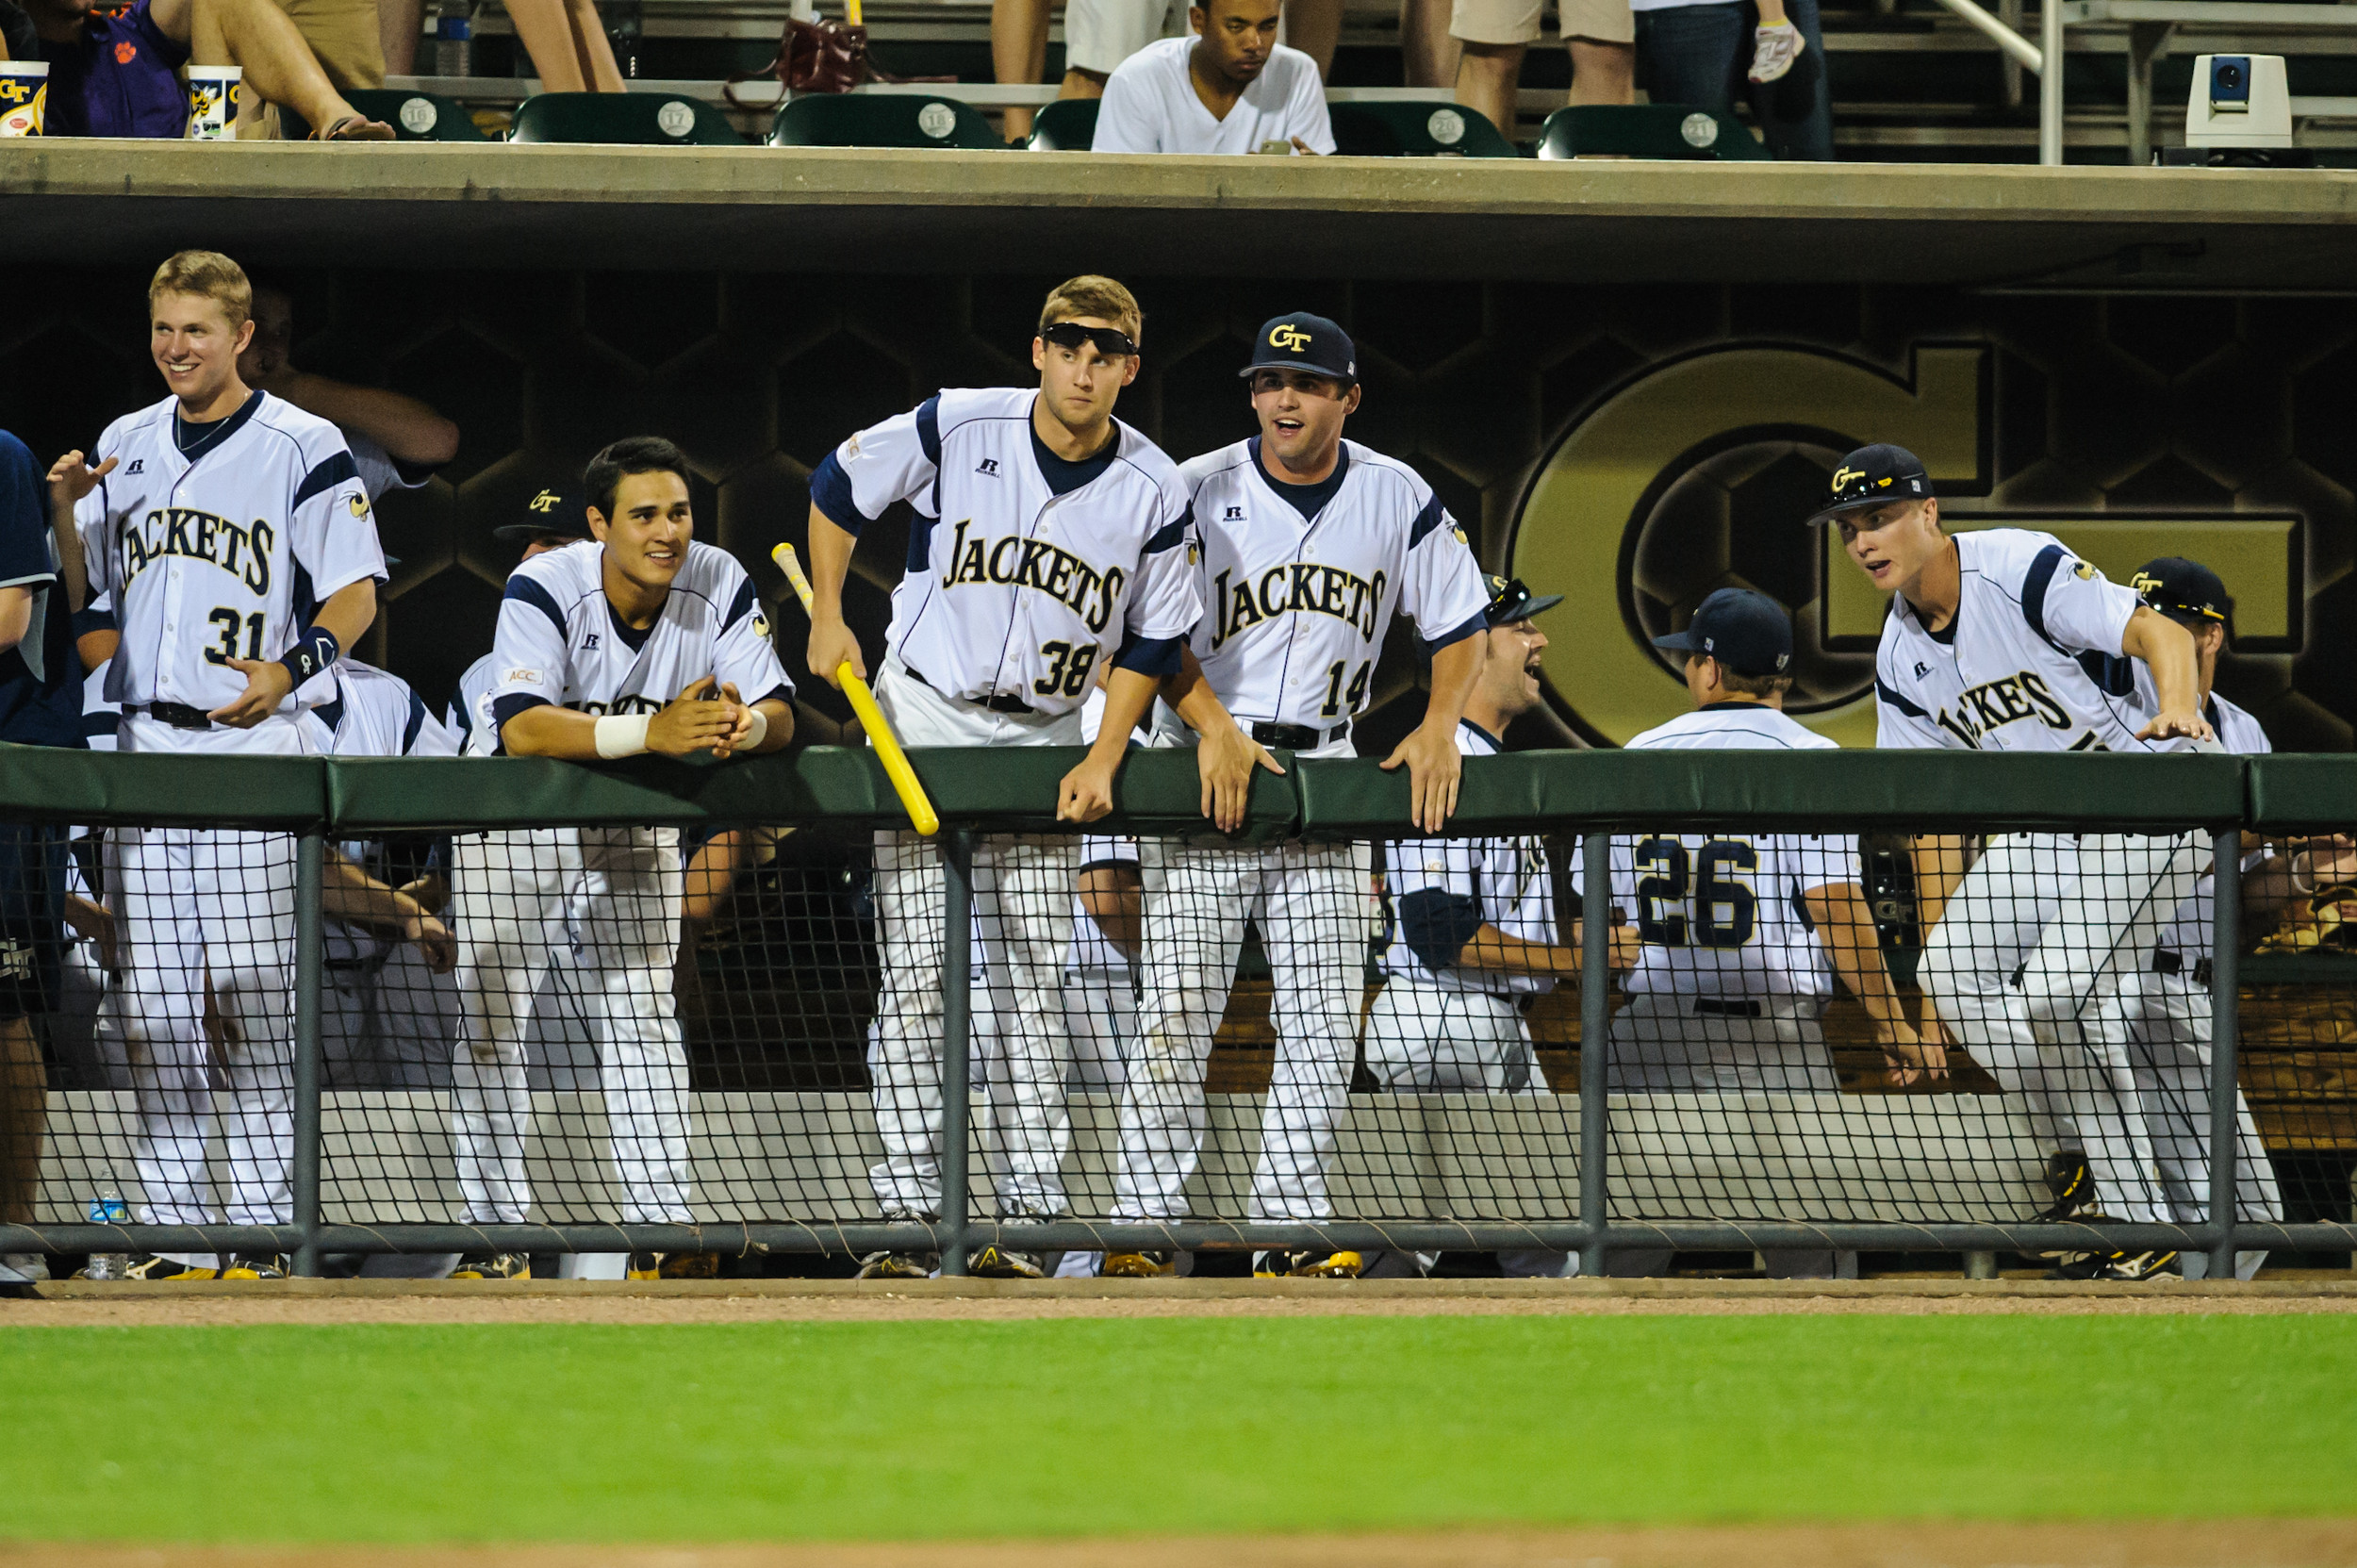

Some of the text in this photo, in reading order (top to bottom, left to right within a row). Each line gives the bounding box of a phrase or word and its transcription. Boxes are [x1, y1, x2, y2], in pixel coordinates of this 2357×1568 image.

[0, 79, 30, 103] GT
[408, 108, 428, 122] 16
[666, 112, 684, 124] 17
[928, 114, 946, 125] 18
[1436, 120, 1455, 132] 20
[1269, 324, 1311, 353] GT
[529, 488, 561, 512] GT
[120, 506, 274, 598] ACKETS
[943, 518, 1125, 635] JACKETS
[1211, 562, 1387, 651] JACKETS
[204, 605, 267, 667] 31
[509, 669, 537, 684] ACC
[1034, 639, 1098, 699] 38
[1321, 658, 1373, 718] 14
[1634, 834, 1760, 951] 26
